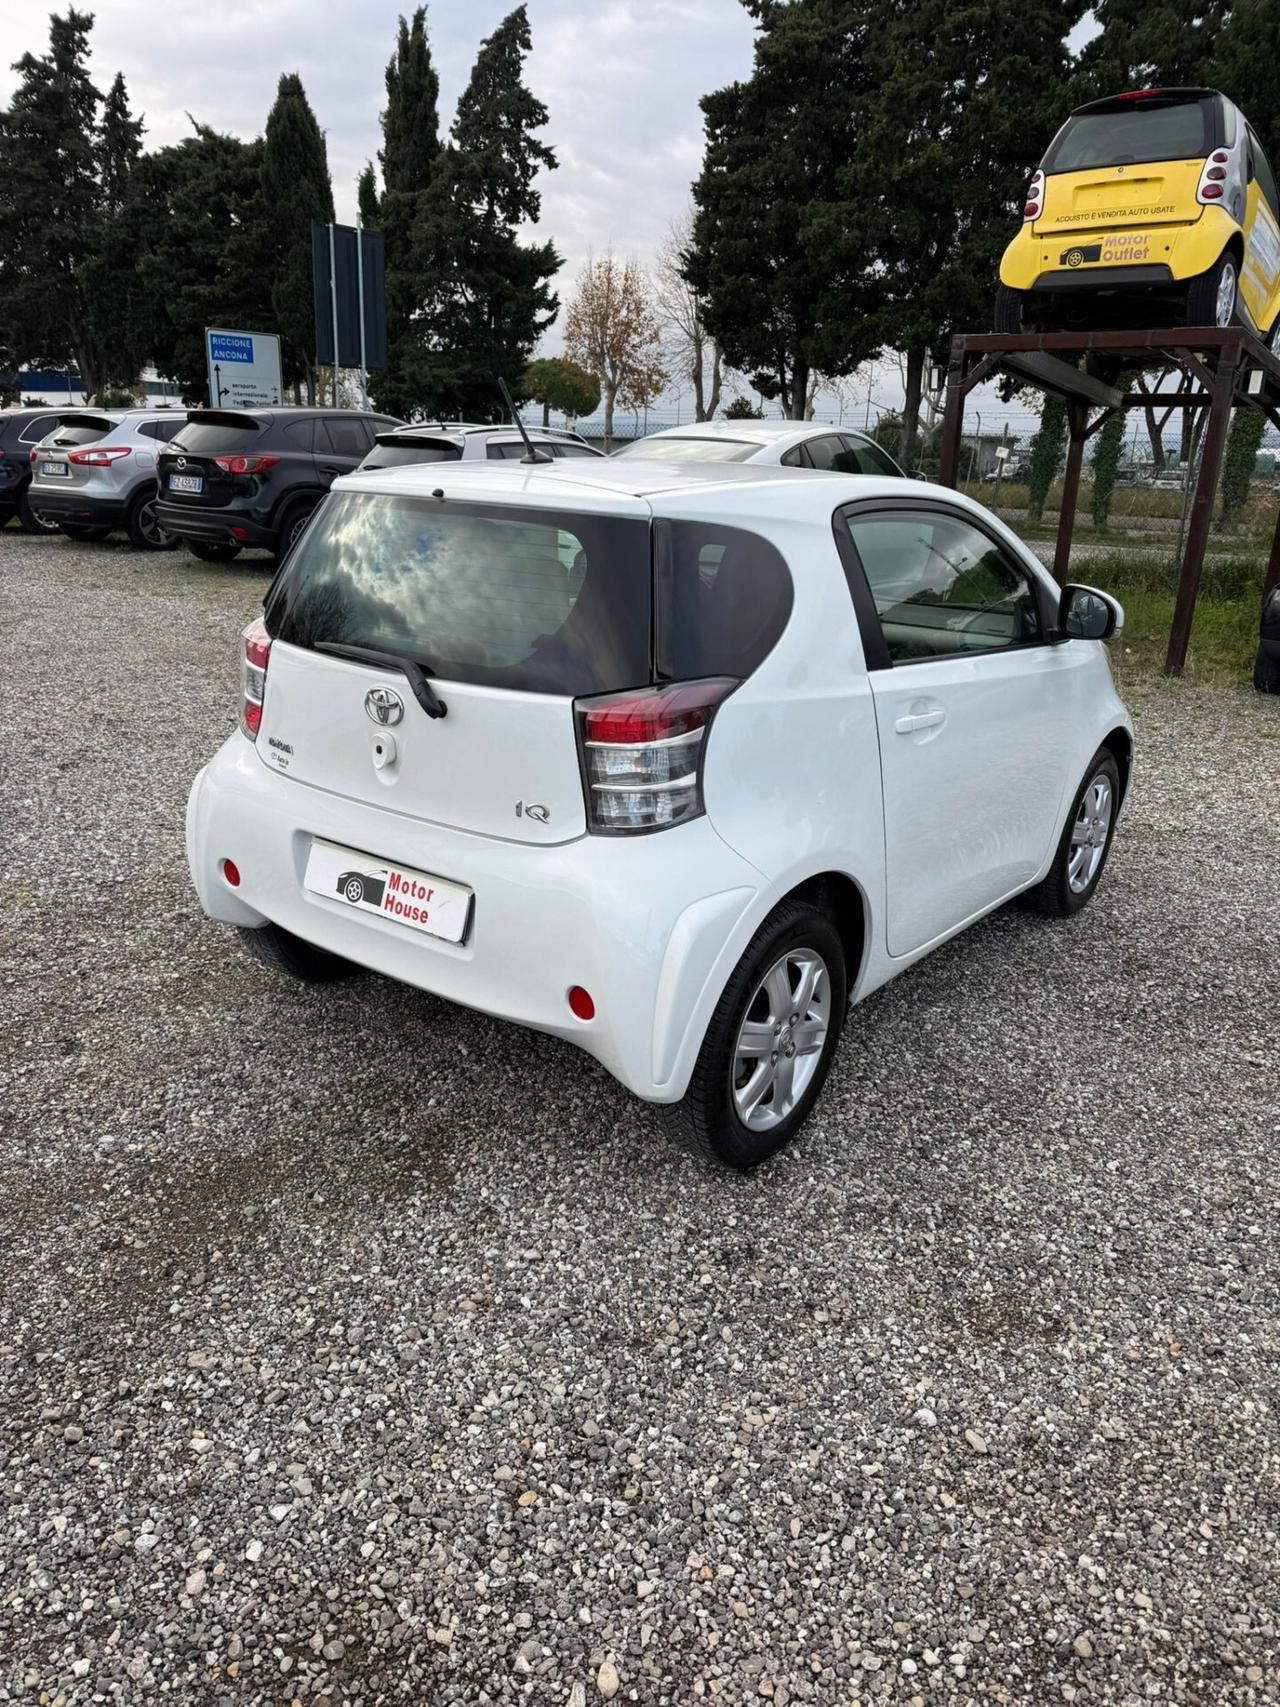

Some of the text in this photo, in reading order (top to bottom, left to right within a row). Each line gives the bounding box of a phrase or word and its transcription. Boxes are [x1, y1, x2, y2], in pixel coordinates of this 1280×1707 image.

[1055, 213, 1090, 223] ACQUISTO
[1097, 209, 1127, 219] VENDITA
[1128, 207, 1150, 217] AUTO
[1150, 205, 1176, 214] USATE
[212, 336, 251, 348] RICCIONE
[214, 350, 248, 360] ANCONA
[388, 872, 434, 902] Motor
[384, 893, 429, 924] House
